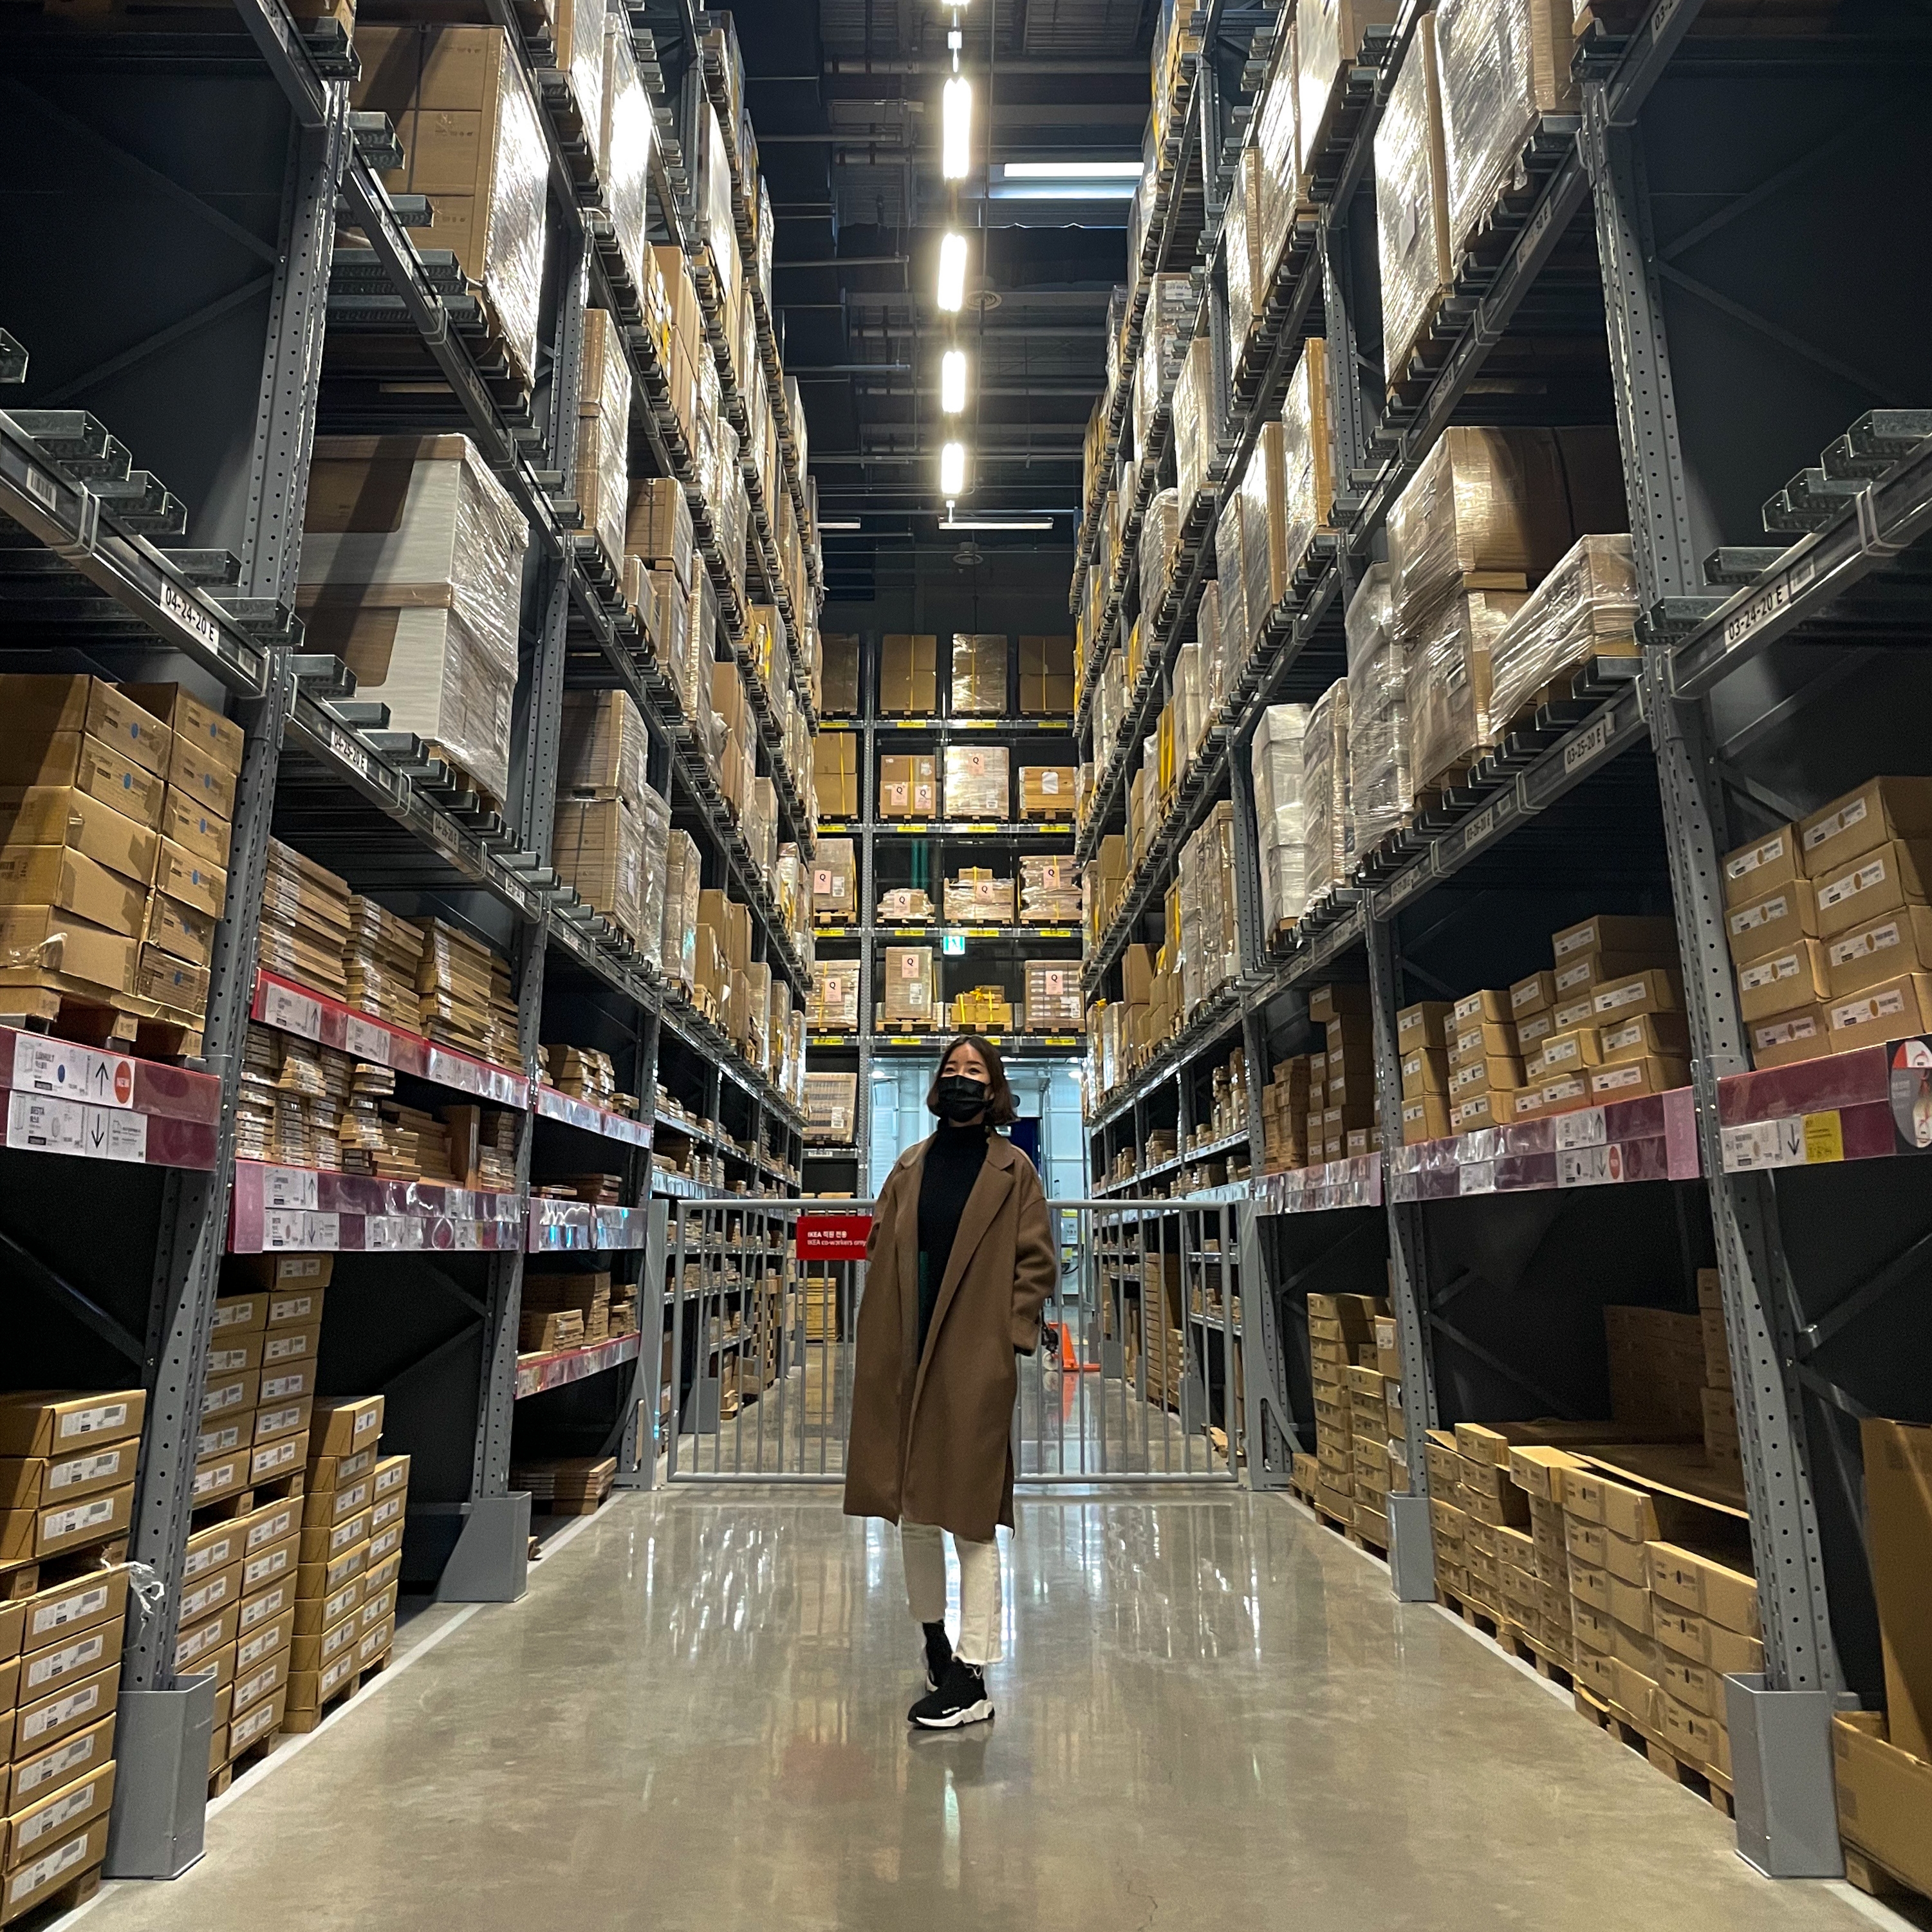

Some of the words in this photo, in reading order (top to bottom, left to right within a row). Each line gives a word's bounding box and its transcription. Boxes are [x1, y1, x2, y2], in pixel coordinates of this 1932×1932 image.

[166, 587, 206, 635] 04-24-20
[209, 623, 214, 642] E
[1729, 592, 1773, 640] 03-24-20
[1776, 585, 1783, 604] E
[1567, 732, 1595, 765] 03-25-20
[1597, 728, 1601, 743] E
[361, 755, 364, 769] E
[920, 789, 926, 798] Q
[819, 873, 826, 882] Q
[1048, 869, 1055, 877] Q
[907, 958, 913, 966] Q
[1051, 974, 1057, 983] Q
[829, 981, 836, 990] Q
